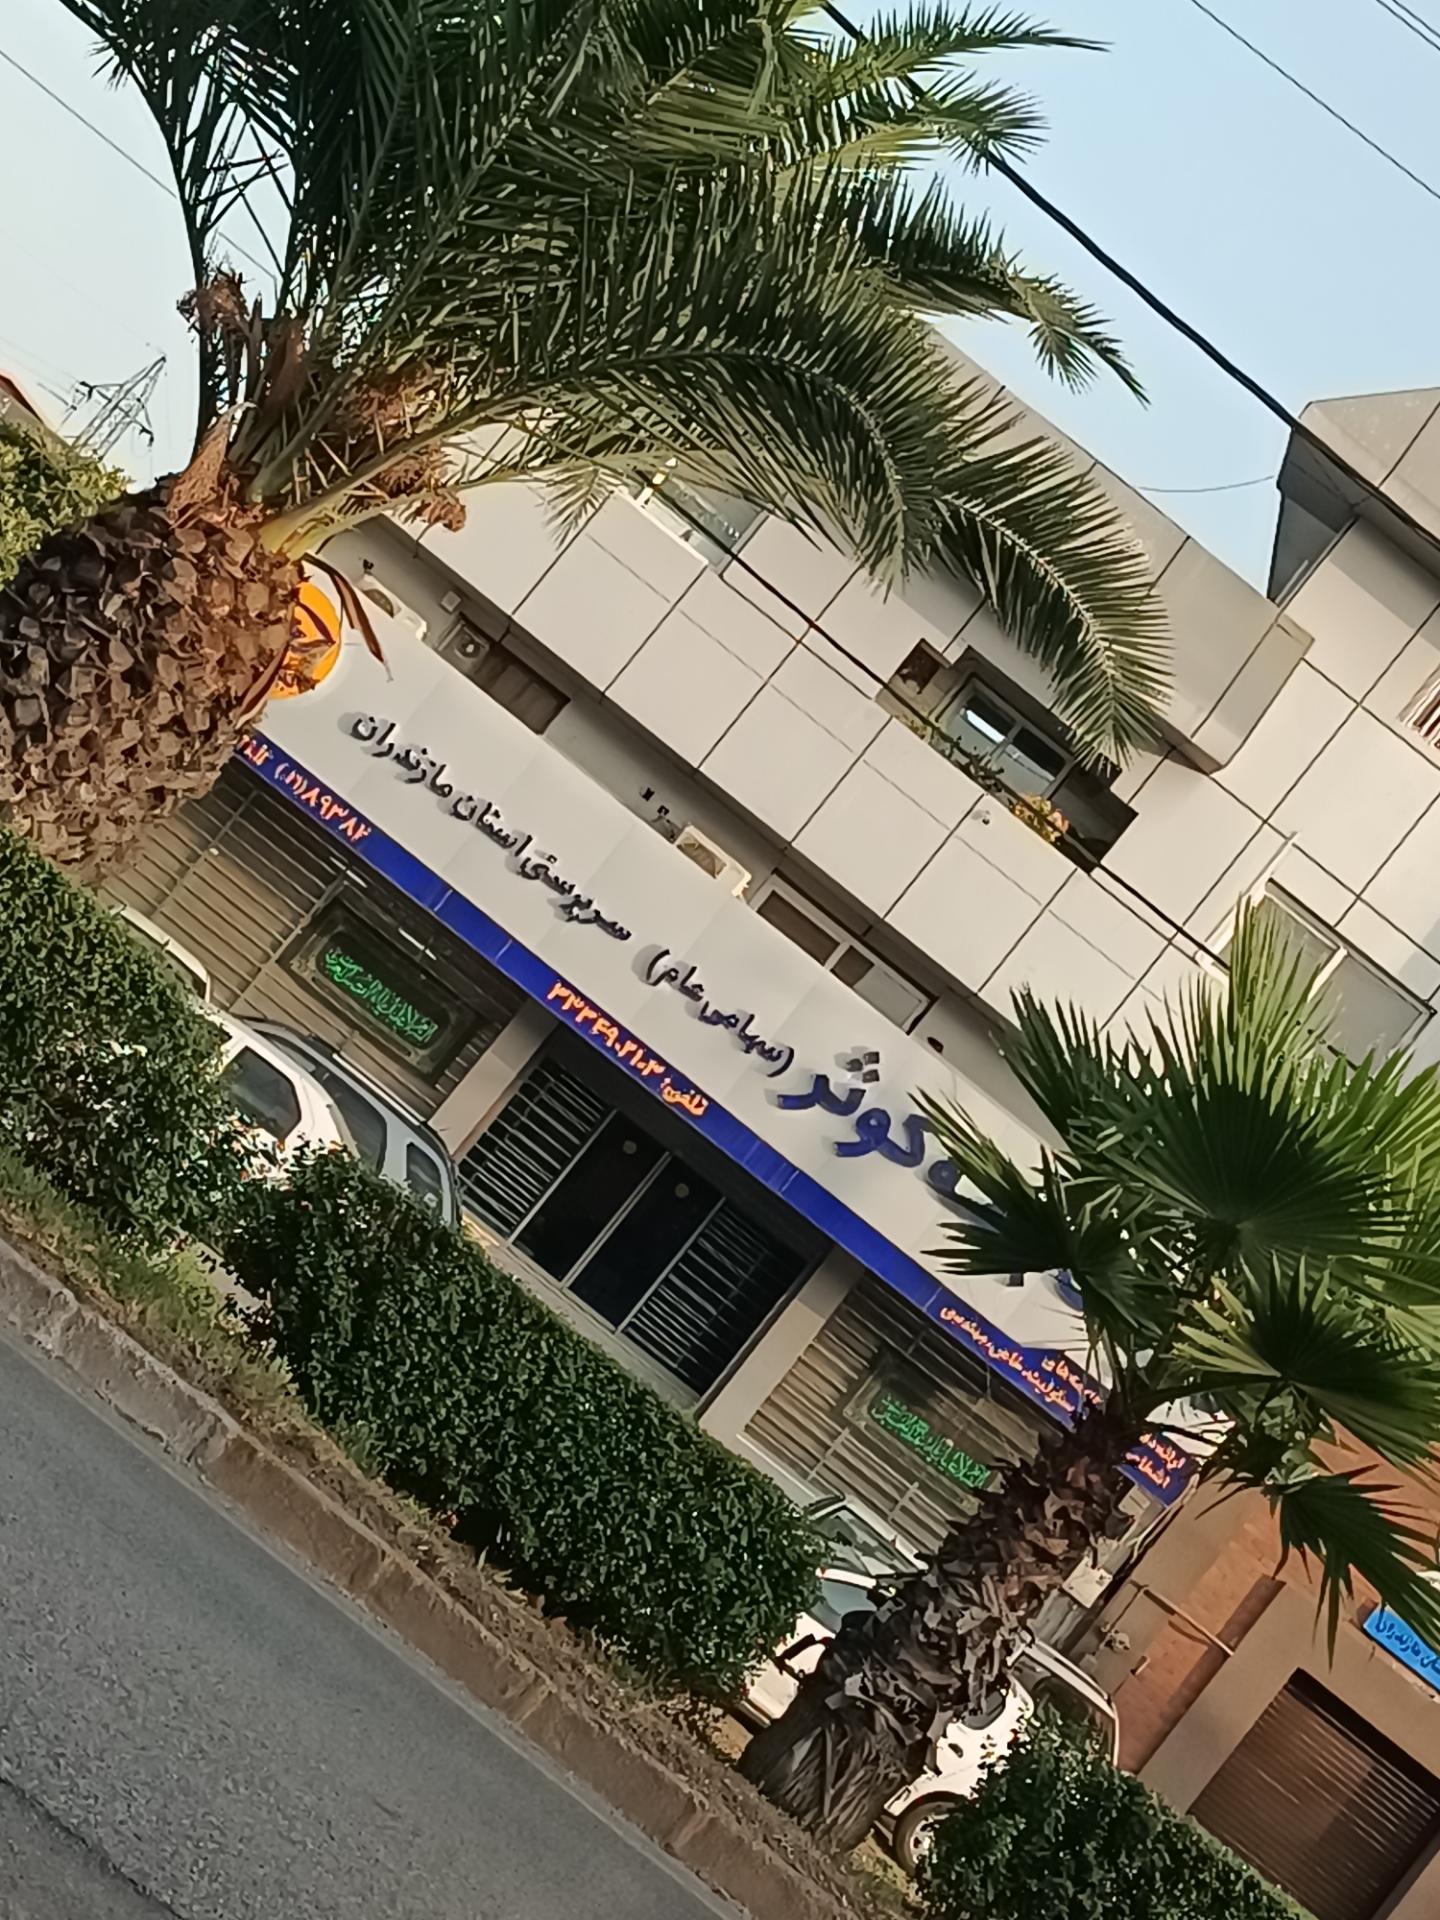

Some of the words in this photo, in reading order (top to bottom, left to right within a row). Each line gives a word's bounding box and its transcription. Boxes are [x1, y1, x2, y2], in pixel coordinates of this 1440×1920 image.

[351, 716, 453, 798] مازندران
[450, 795, 533, 857] استان
[517, 855, 632, 938] سرپرستی
[778, 1051, 942, 1168] کوثر
